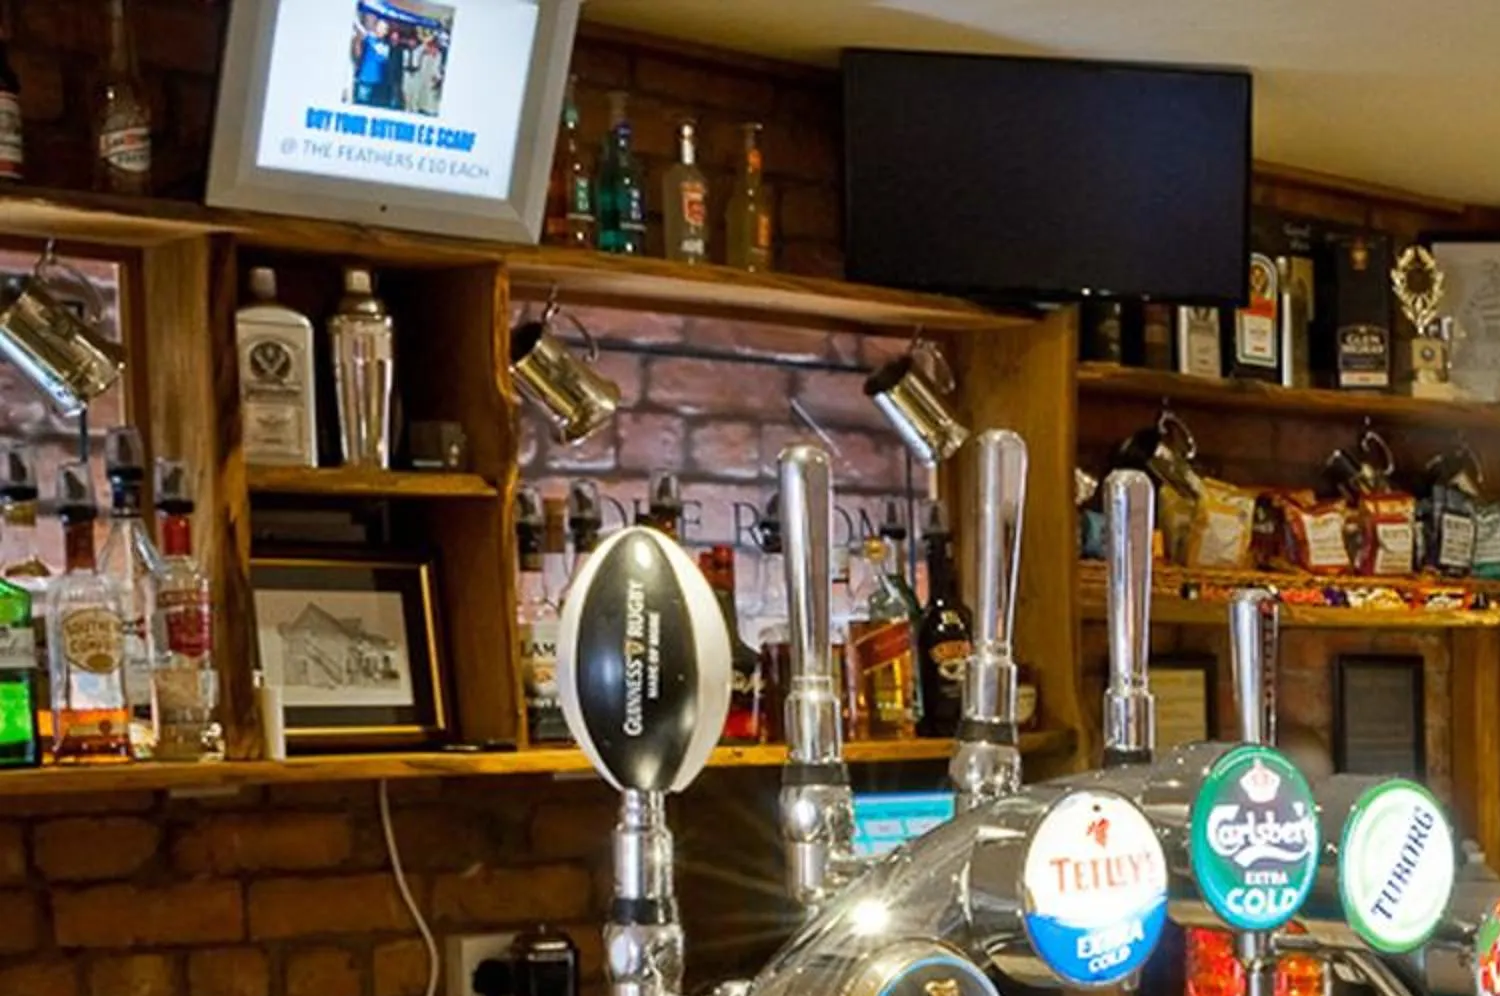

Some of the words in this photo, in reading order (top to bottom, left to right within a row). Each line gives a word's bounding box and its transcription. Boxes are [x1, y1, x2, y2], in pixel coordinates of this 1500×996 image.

[303, 140, 335, 158] THE
[337, 144, 414, 170] FEATHERS
[449, 158, 490, 178] EACH
[626, 579, 645, 638] RUGBY
[521, 642, 557, 657] LAM
[622, 658, 644, 737] GUINNESS
[1206, 803, 1318, 867] Carlsberg
[1245, 870, 1288, 885] EXTRA
[1370, 804, 1435, 922] TUBORG
[1226, 888, 1298, 916] COLD
